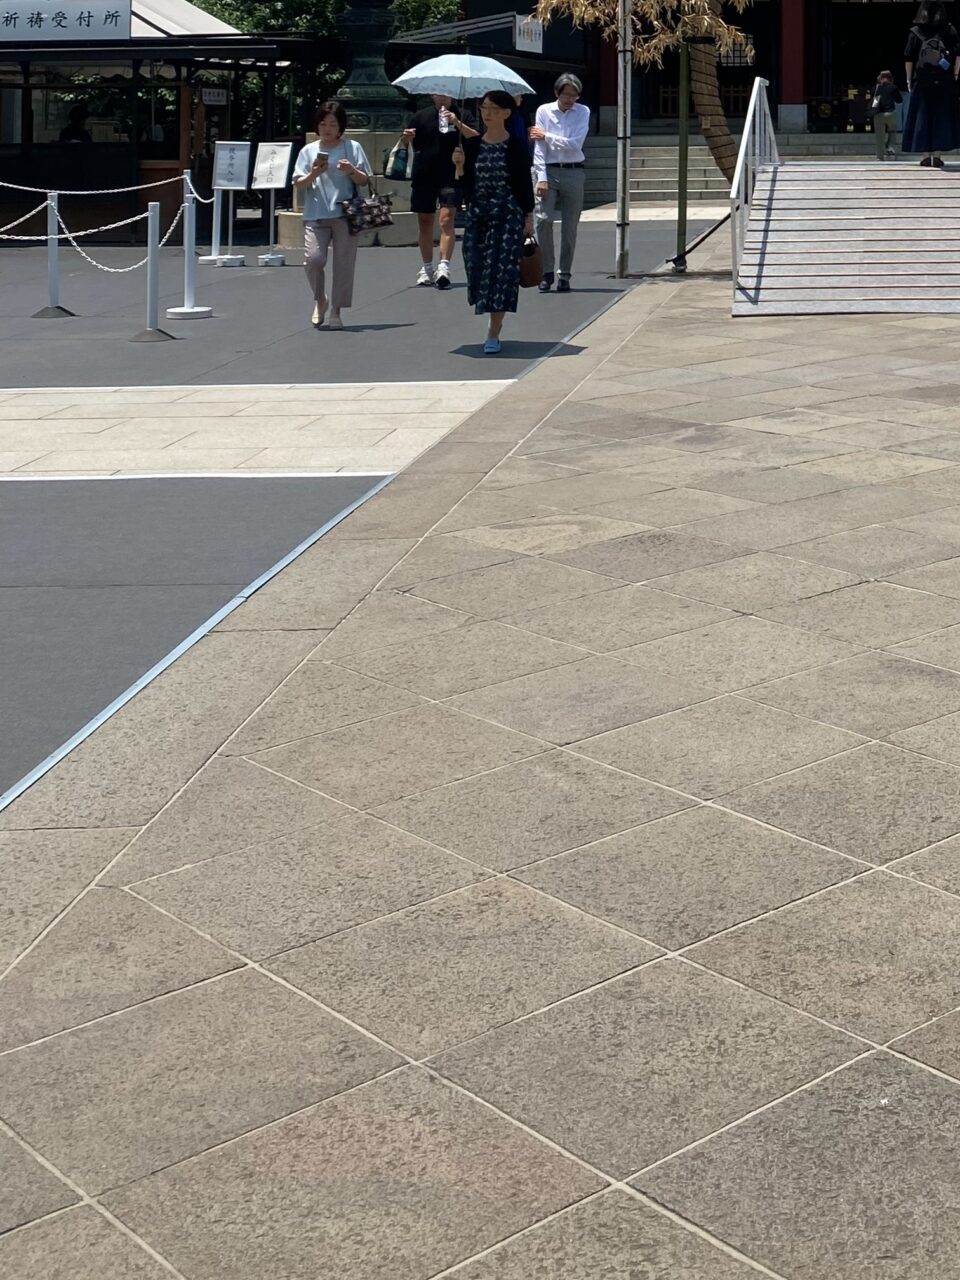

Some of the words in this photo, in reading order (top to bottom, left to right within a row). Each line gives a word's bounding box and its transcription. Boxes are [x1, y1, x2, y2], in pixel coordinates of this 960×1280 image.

[1, 10, 121, 29] 祈祷受付所
